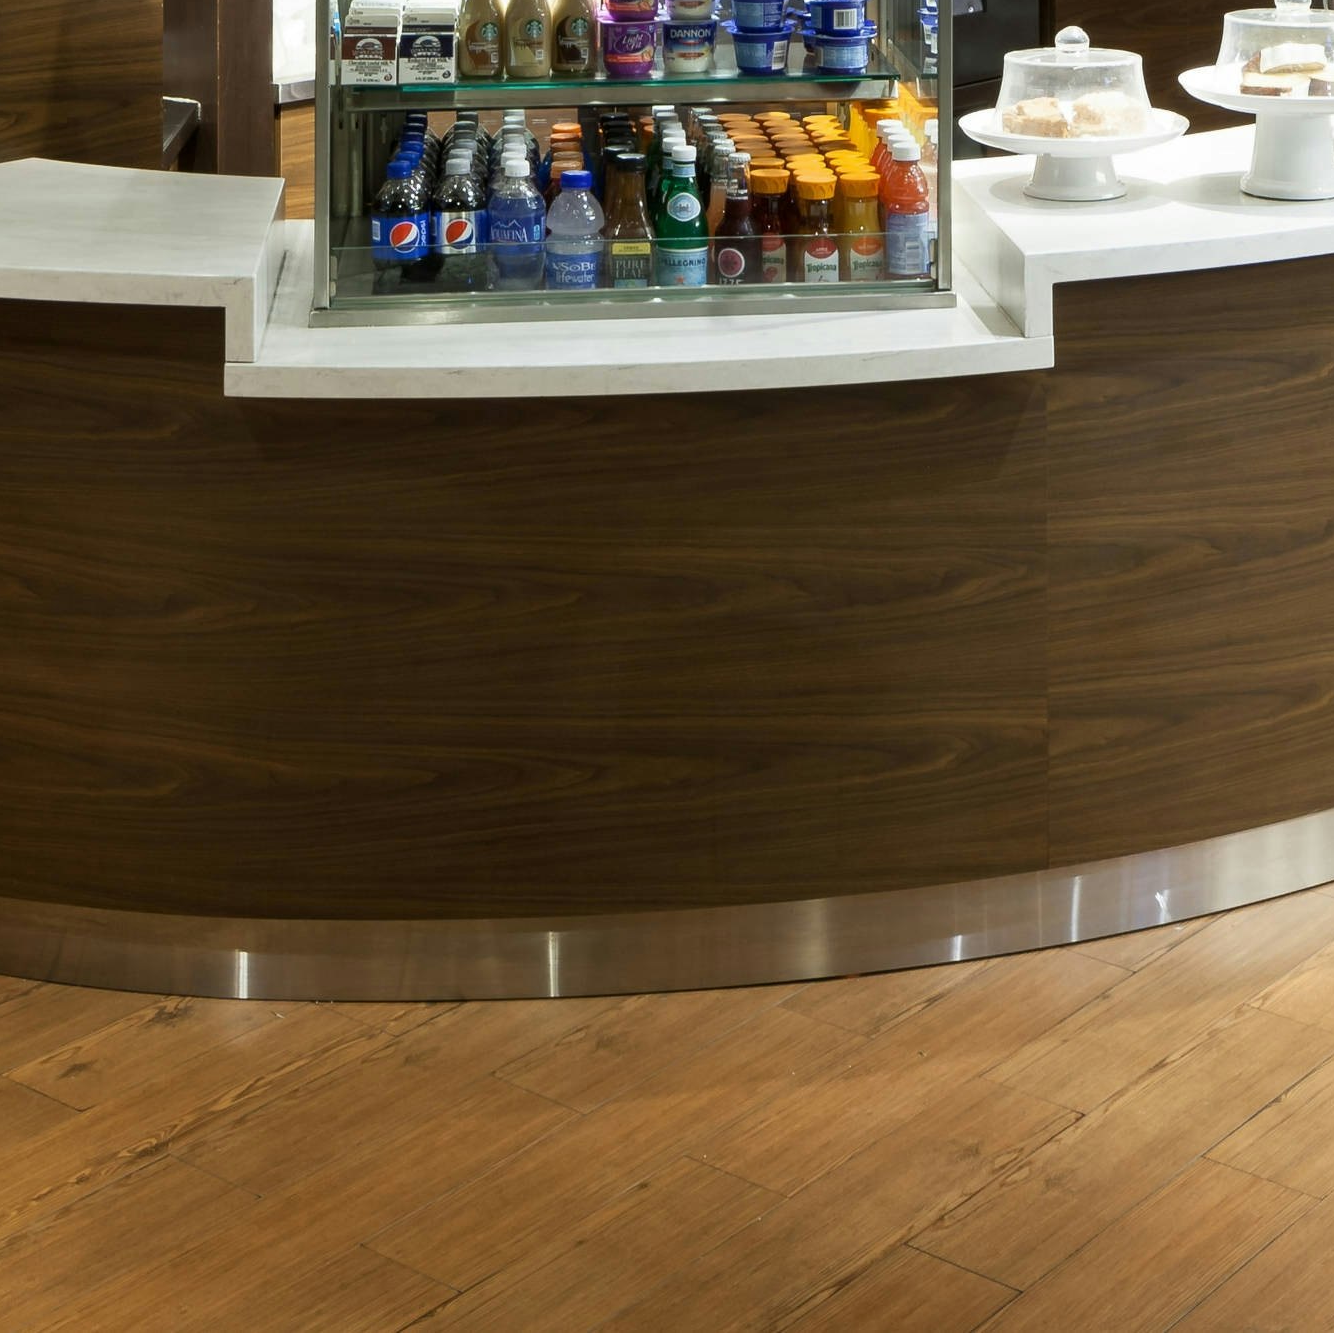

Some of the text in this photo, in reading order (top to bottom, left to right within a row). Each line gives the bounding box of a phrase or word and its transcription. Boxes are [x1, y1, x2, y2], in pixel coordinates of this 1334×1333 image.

[670, 29, 711, 38] DANNON
[807, 264, 837, 272] Tropicana
[555, 271, 595, 283] lifewater
